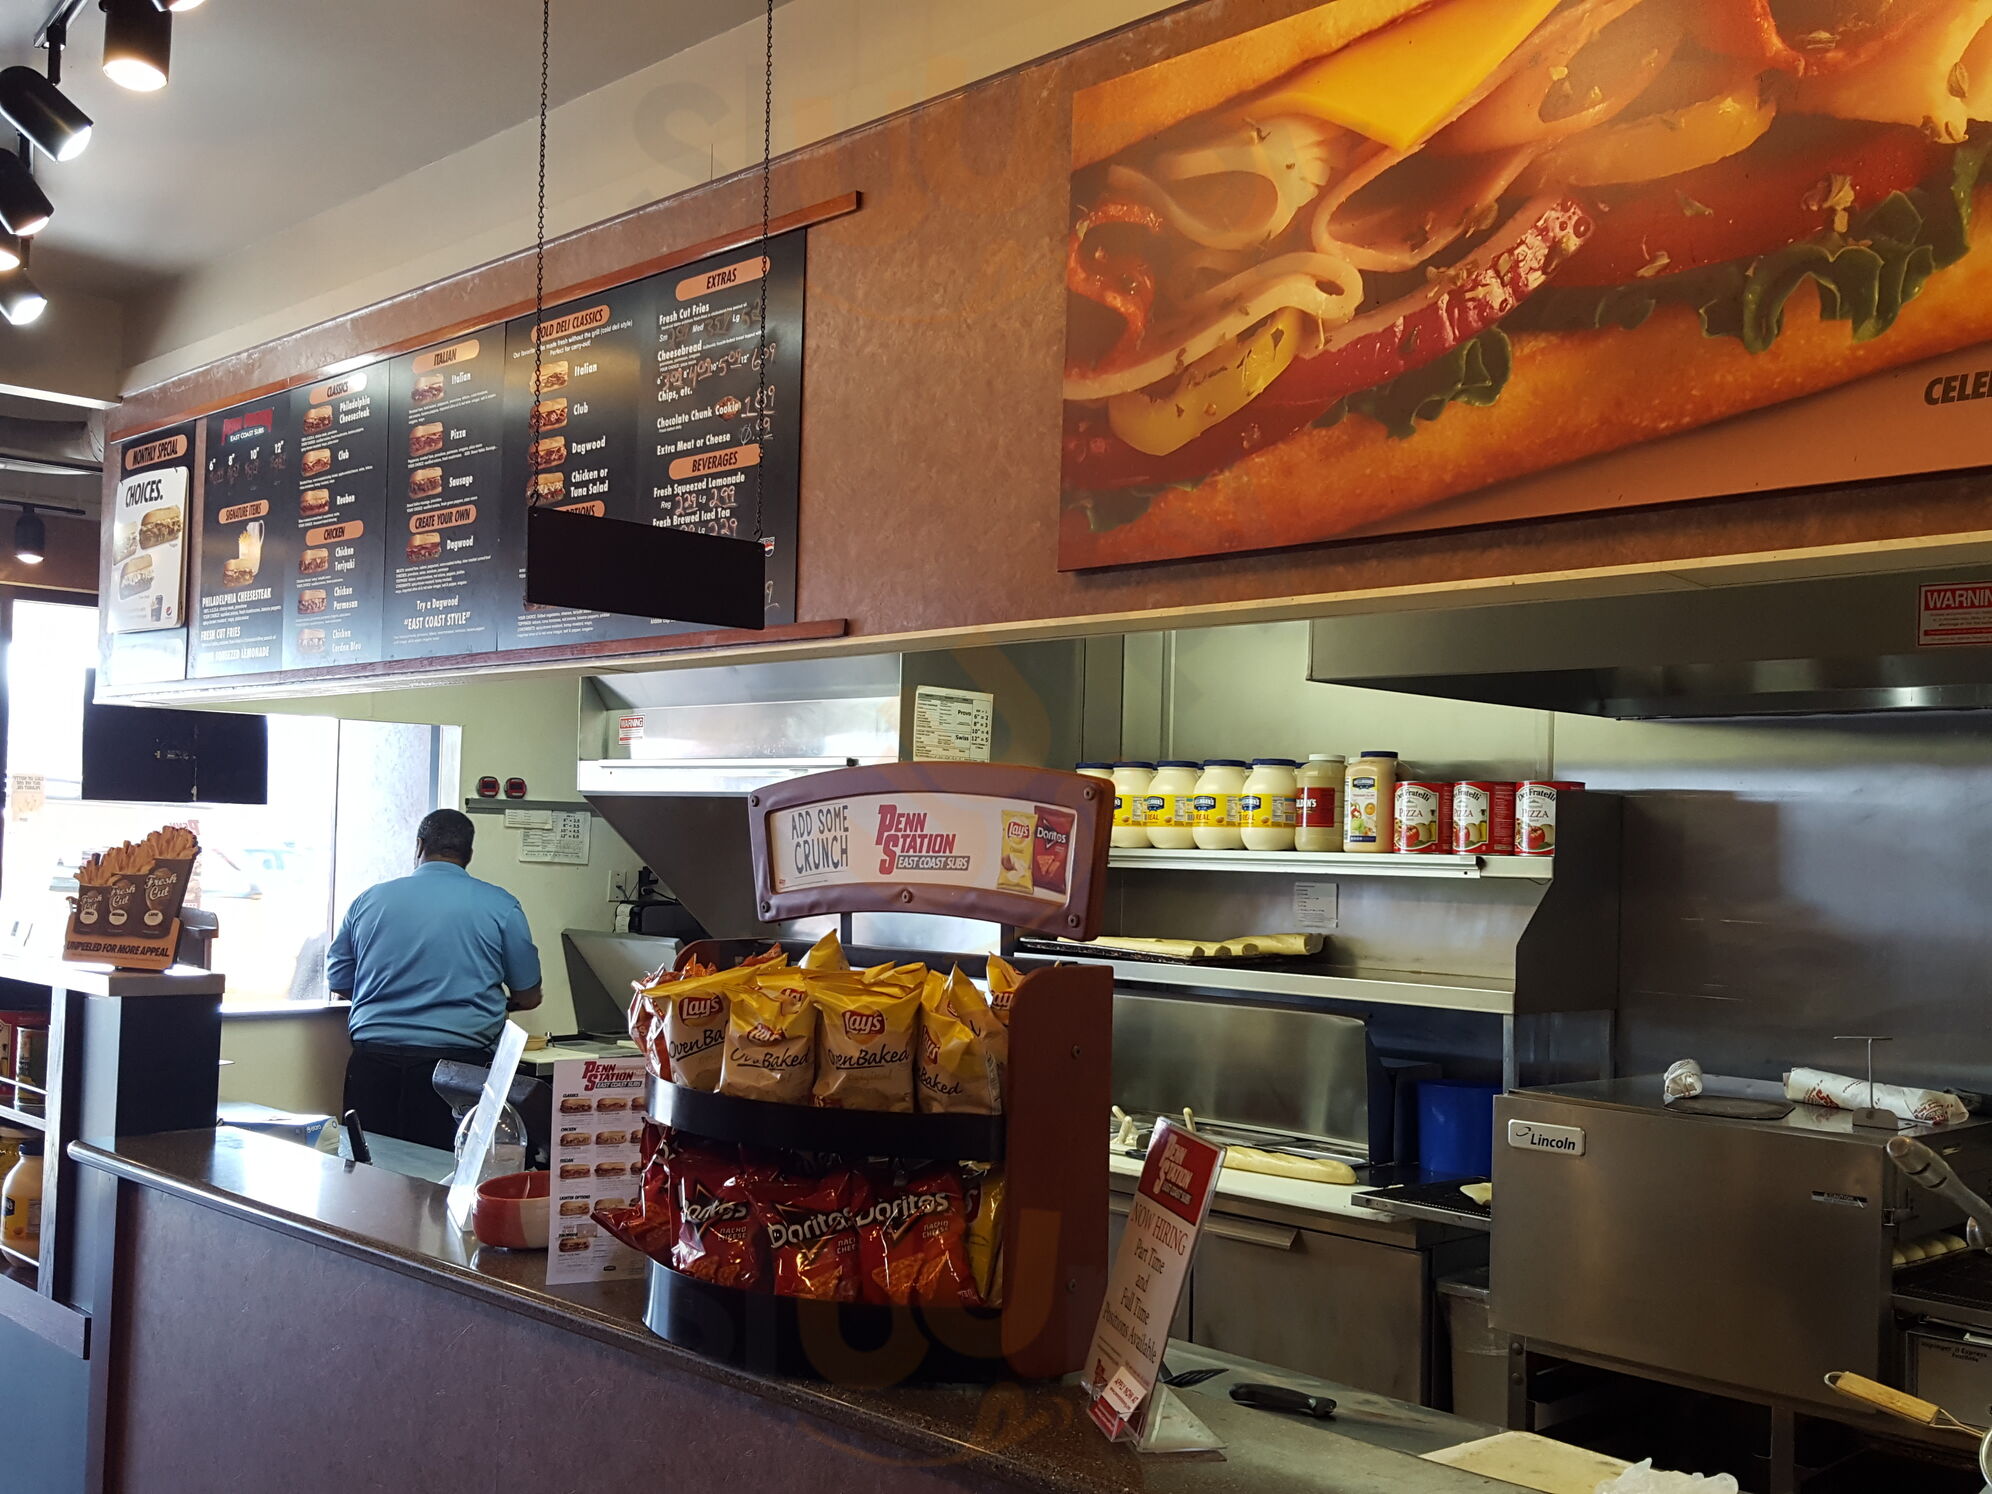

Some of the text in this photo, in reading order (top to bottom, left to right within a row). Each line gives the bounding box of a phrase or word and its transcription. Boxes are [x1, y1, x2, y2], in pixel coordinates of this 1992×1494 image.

[706, 268, 737, 290] EXTRAS
[556, 309, 603, 334] DELI CLASSICS
[659, 310, 677, 326] Fresh
[679, 308, 691, 319] Cut
[692, 303, 709, 316] Fries
[692, 323, 705, 333] Med
[732, 314, 740, 323] Lg
[513, 351, 521, 359] Our
[546, 342, 557, 350] made
[558, 338, 568, 347] fresh
[569, 334, 584, 345] without
[620, 320, 632, 330] style)
[433, 348, 457, 366] ITALIAN
[549, 348, 564, 356] Perfect
[657, 340, 702, 361] Cheesebread
[574, 362, 597, 376] Italian
[451, 372, 471, 385] Italian
[326, 381, 348, 398] CLASSICS
[658, 386, 692, 402] Chips, etc.
[340, 395, 370, 412] Philadelphia
[573, 402, 588, 415] Club
[339, 407, 370, 424] Cheesesteak
[657, 416, 689, 429] Chocolate
[691, 406, 712, 421] Chunk
[450, 429, 466, 440] Pizza
[132, 438, 178, 467] MONTHLY SPECIAL
[250, 446, 260, 460] 10"
[274, 440, 284, 454] 12"
[572, 435, 606, 455] Dagwood
[657, 433, 731, 456] Extra Meat or Cheese
[228, 453, 235, 466] 8"
[338, 449, 349, 461] Club
[692, 451, 738, 473] BEVERAGES
[209, 458, 216, 471] 6"
[449, 475, 473, 488] Sausage
[571, 467, 608, 483] Chicken or
[570, 480, 609, 498] Tuna Salad
[653, 471, 745, 498] Fresh Squeezed Lemonade
[125, 479, 163, 508] CHOICES.
[337, 494, 355, 506] Reuben
[225, 506, 249, 522] SIGNATURE
[660, 501, 671, 510] Reg
[415, 508, 471, 529] CREATE YOUR OWN
[653, 507, 730, 527] Fresh Brewed Iced Tea
[323, 526, 346, 541] CHICKEN
[335, 546, 354, 558] Chicken
[447, 536, 474, 552] Dagwood
[335, 559, 355, 572] Teriyaki
[202, 587, 272, 608] PHILADELPHIA CHEESESTEAK
[334, 585, 353, 597] Chicken
[333, 600, 358, 611] Parmesan
[416, 600, 426, 612] Try
[432, 595, 459, 610] Dagwood
[425, 614, 446, 628] COAST
[1405, 787, 1432, 802] Fratelli
[1457, 788, 1482, 802] Fratelli
[1195, 813, 1210, 821] REAL
[1399, 809, 1423, 818] PIZZA
[1454, 809, 1474, 818] PIZZA
[1522, 809, 1549, 819] PIZZA
[792, 805, 849, 841] ADD SOME
[875, 804, 927, 846] PENN
[1008, 821, 1029, 839] Lay's
[1037, 826, 1067, 843] Doritos
[795, 835, 849, 874] CRUNCH
[878, 833, 957, 876] STATION
[898, 857, 969, 870] EAST COAST SUBS
[145, 873, 177, 889] Fresh
[111, 884, 136, 897] Fresh
[150, 885, 169, 900] Cut
[112, 895, 128, 907] Cut
[66, 940, 170, 958] UNPEELED FOR MORE APPEAL
[682, 993, 722, 1019] Lay's
[846, 1009, 886, 1034] Lay's
[762, 1046, 810, 1069] Baked
[582, 1061, 616, 1079] PENN
[584, 1072, 633, 1091] STATION
[1530, 1133, 1576, 1151] Lincoln
[719, 1225, 748, 1235] NACHO
[922, 1219, 949, 1231] NACHO
[1132, 1200, 1188, 1256] NOW HIRING
[1134, 1237, 1165, 1274] Part Time
[1135, 1273, 1150, 1293] and
[1121, 1287, 1150, 1326] Full Time
[1102, 1301, 1157, 1364] Positions Available
